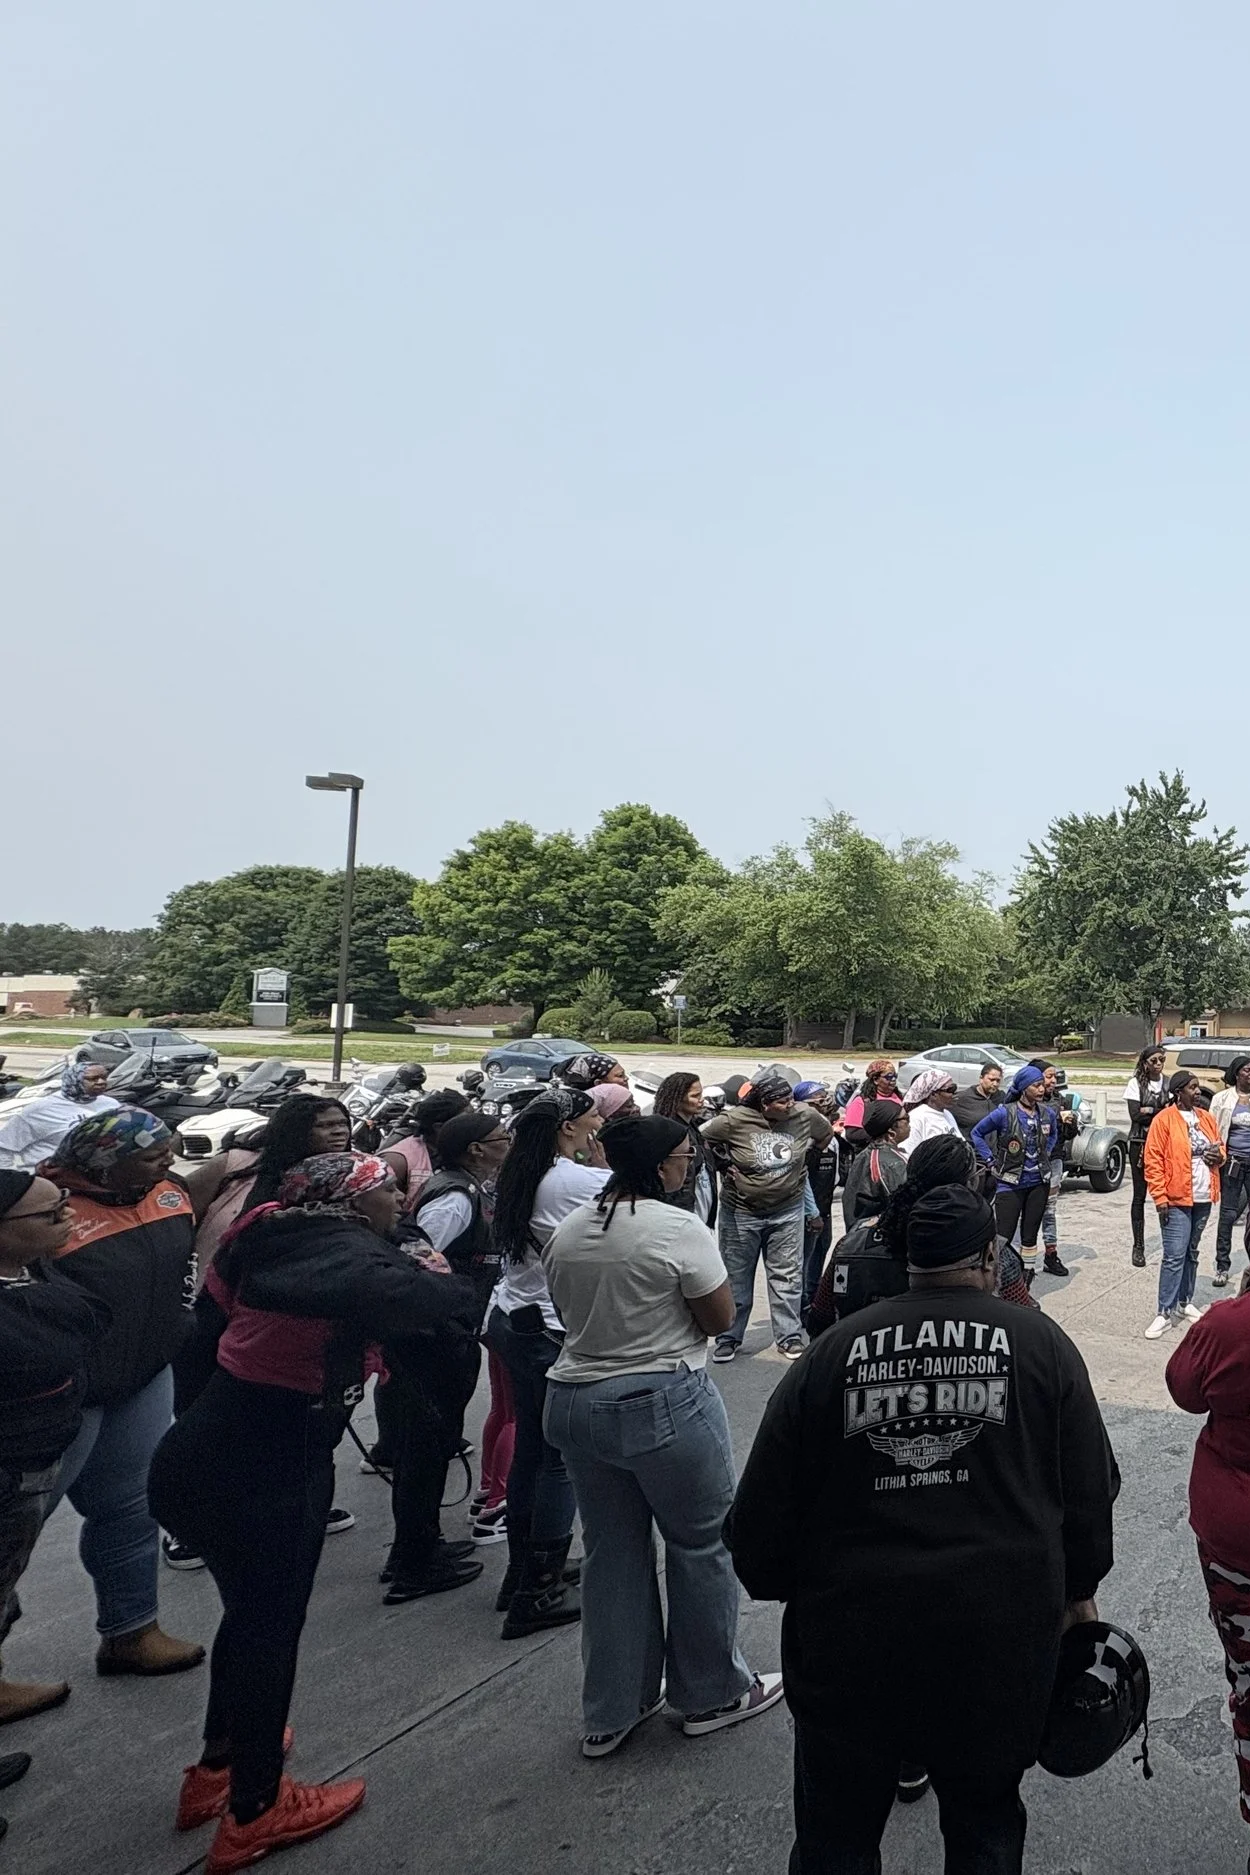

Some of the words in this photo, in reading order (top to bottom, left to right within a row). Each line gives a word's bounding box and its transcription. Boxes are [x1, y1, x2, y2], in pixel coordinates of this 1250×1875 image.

[846, 1320, 1011, 1367] ATLANTA
[846, 1383, 930, 1432] LET'S
[934, 1379, 1006, 1420] RIDE
[874, 1475, 907, 1491] LITHIA
[910, 1470, 953, 1487] SPRINGS,
[956, 1469, 970, 1483] GA
